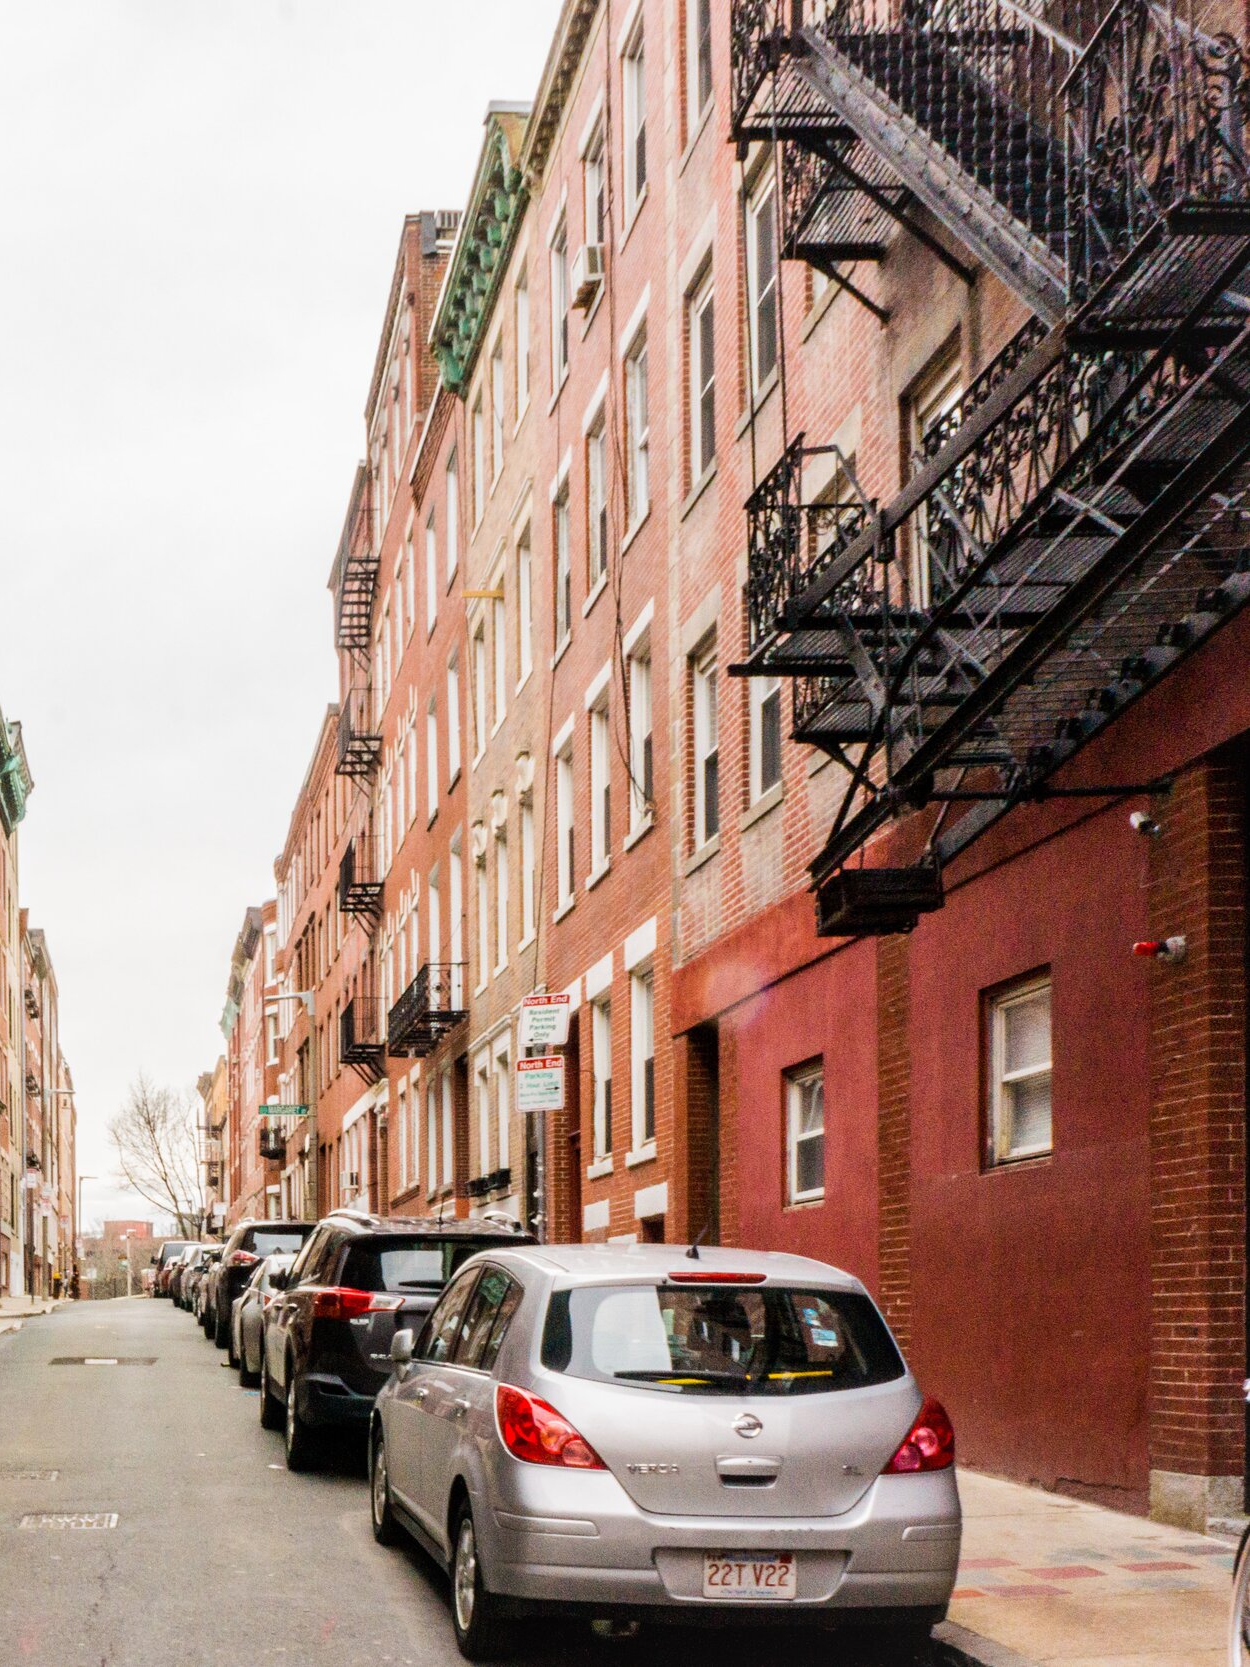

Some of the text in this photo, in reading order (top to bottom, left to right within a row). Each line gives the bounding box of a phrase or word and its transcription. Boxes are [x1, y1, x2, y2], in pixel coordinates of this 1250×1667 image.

[524, 994, 568, 1006] North End
[520, 1059, 563, 1070] North End
[707, 1563, 790, 1586] 22T V22
